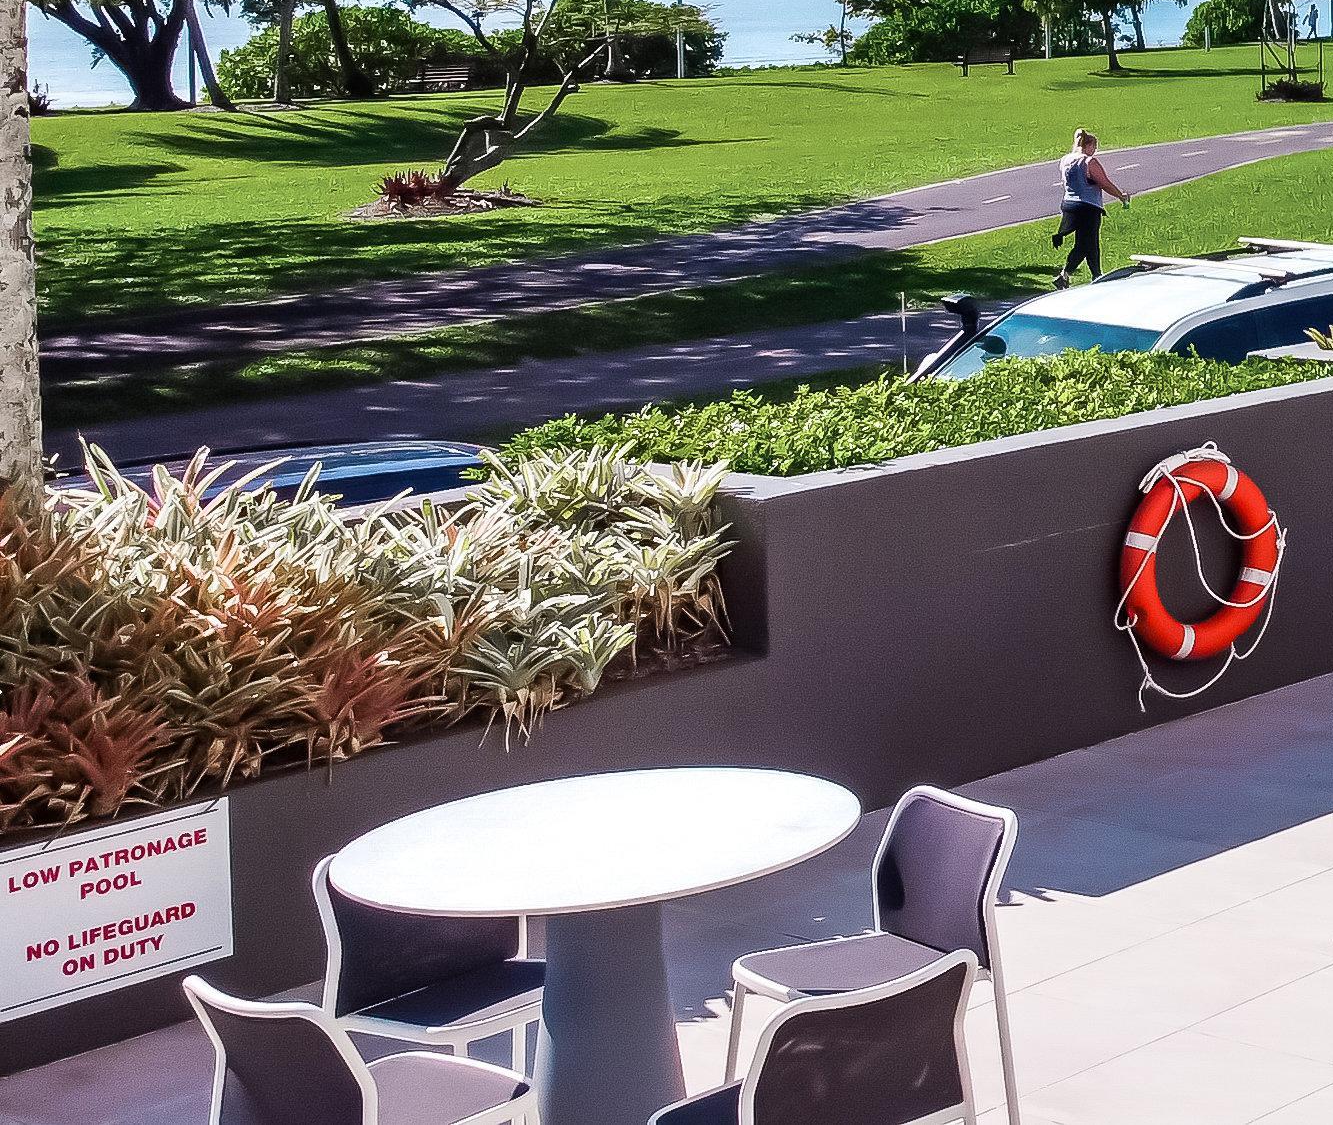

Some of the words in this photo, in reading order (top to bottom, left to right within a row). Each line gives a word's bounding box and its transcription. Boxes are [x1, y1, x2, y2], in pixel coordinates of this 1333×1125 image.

[8, 866, 61, 893] LOW
[69, 828, 208, 877] PATRONAGE
[80, 871, 142, 899] POOL
[26, 939, 60, 962] NO
[69, 902, 197, 950] LIFEGUARD
[62, 954, 96, 976] ON
[103, 935, 164, 965] DUTY
